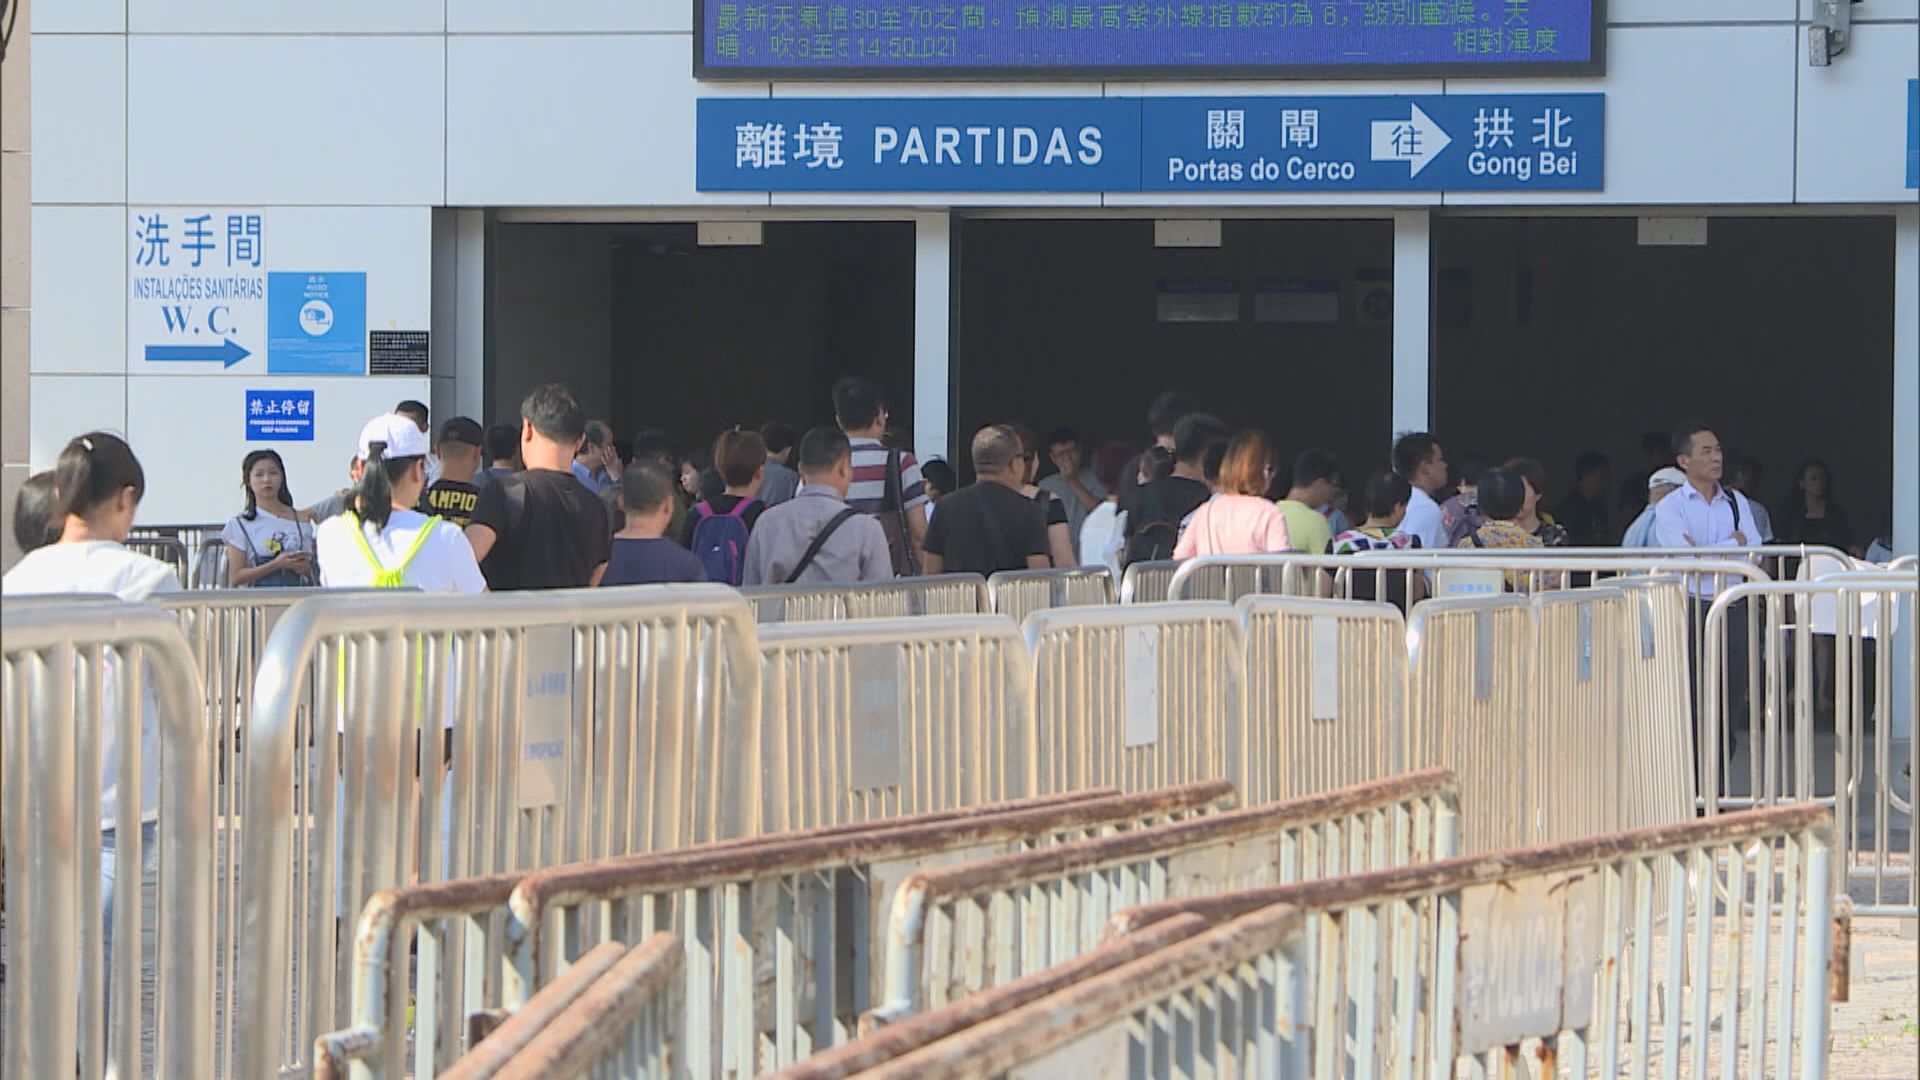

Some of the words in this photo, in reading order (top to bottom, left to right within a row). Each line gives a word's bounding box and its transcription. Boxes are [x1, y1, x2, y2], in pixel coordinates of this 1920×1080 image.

[1391, 125, 1423, 157] 往
[1473, 108, 1572, 149] 拱北
[735, 121, 844, 169] 離境
[873, 126, 1103, 166] PARTIDAS
[1168, 158, 1243, 181] Portas
[1250, 157, 1280, 181] do
[1286, 157, 1355, 181] Cerco
[1468, 151, 1531, 180] Gong
[1539, 151, 1577, 176] Bei
[135, 214, 261, 267] 洗手間
[134, 274, 202, 301] INSTALAÇÕES
[204, 273, 263, 300] SANITÁRIAS
[250, 398, 310, 416] 禁止停留
